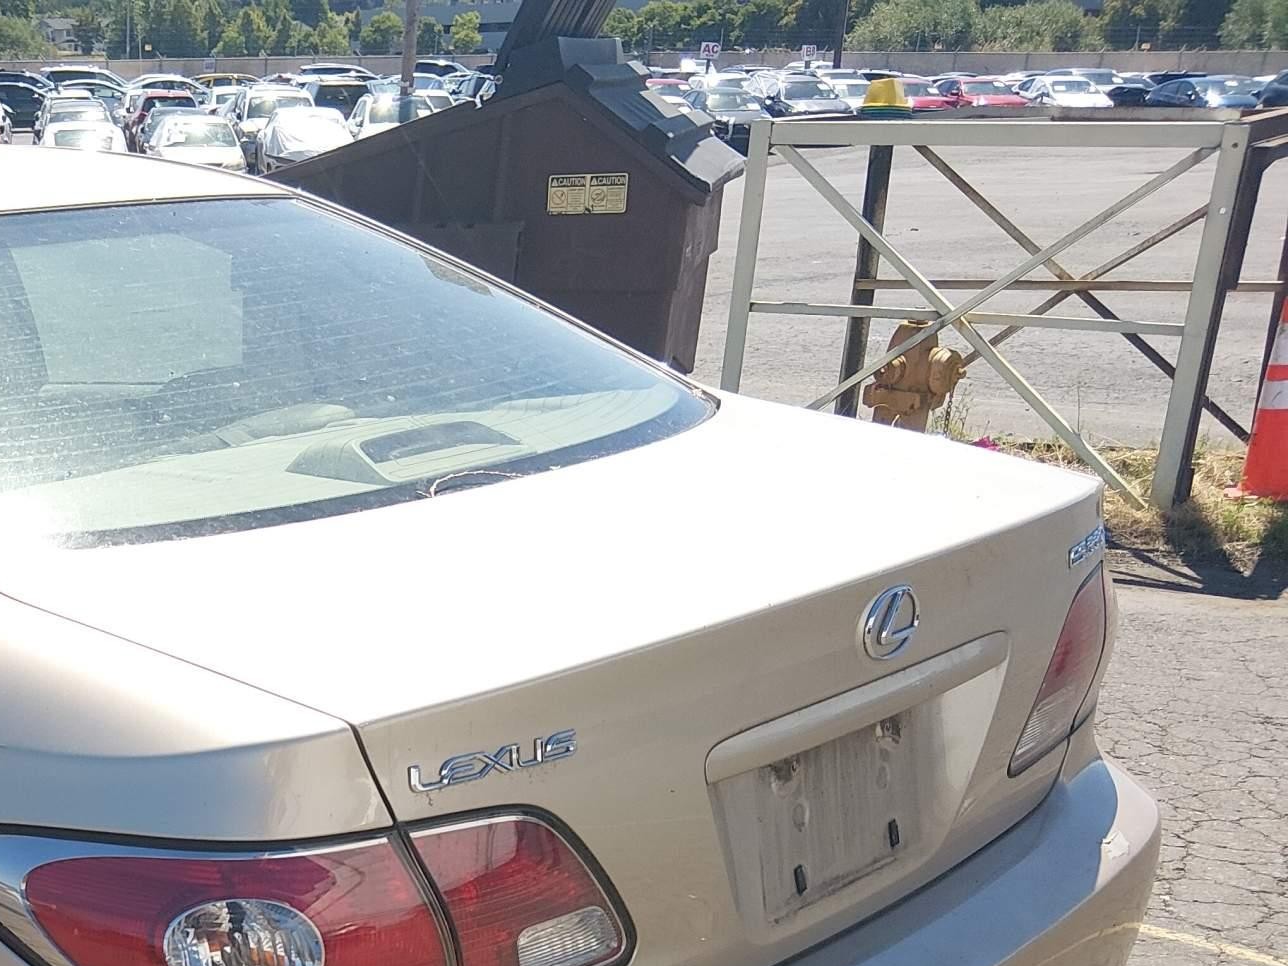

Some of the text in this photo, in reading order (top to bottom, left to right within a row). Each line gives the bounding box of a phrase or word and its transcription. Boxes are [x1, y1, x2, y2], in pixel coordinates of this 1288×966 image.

[702, 43, 719, 54] AC
[558, 177, 586, 186] CAUTION
[598, 176, 626, 185] CAUTION
[408, 728, 577, 793] LEXUS
